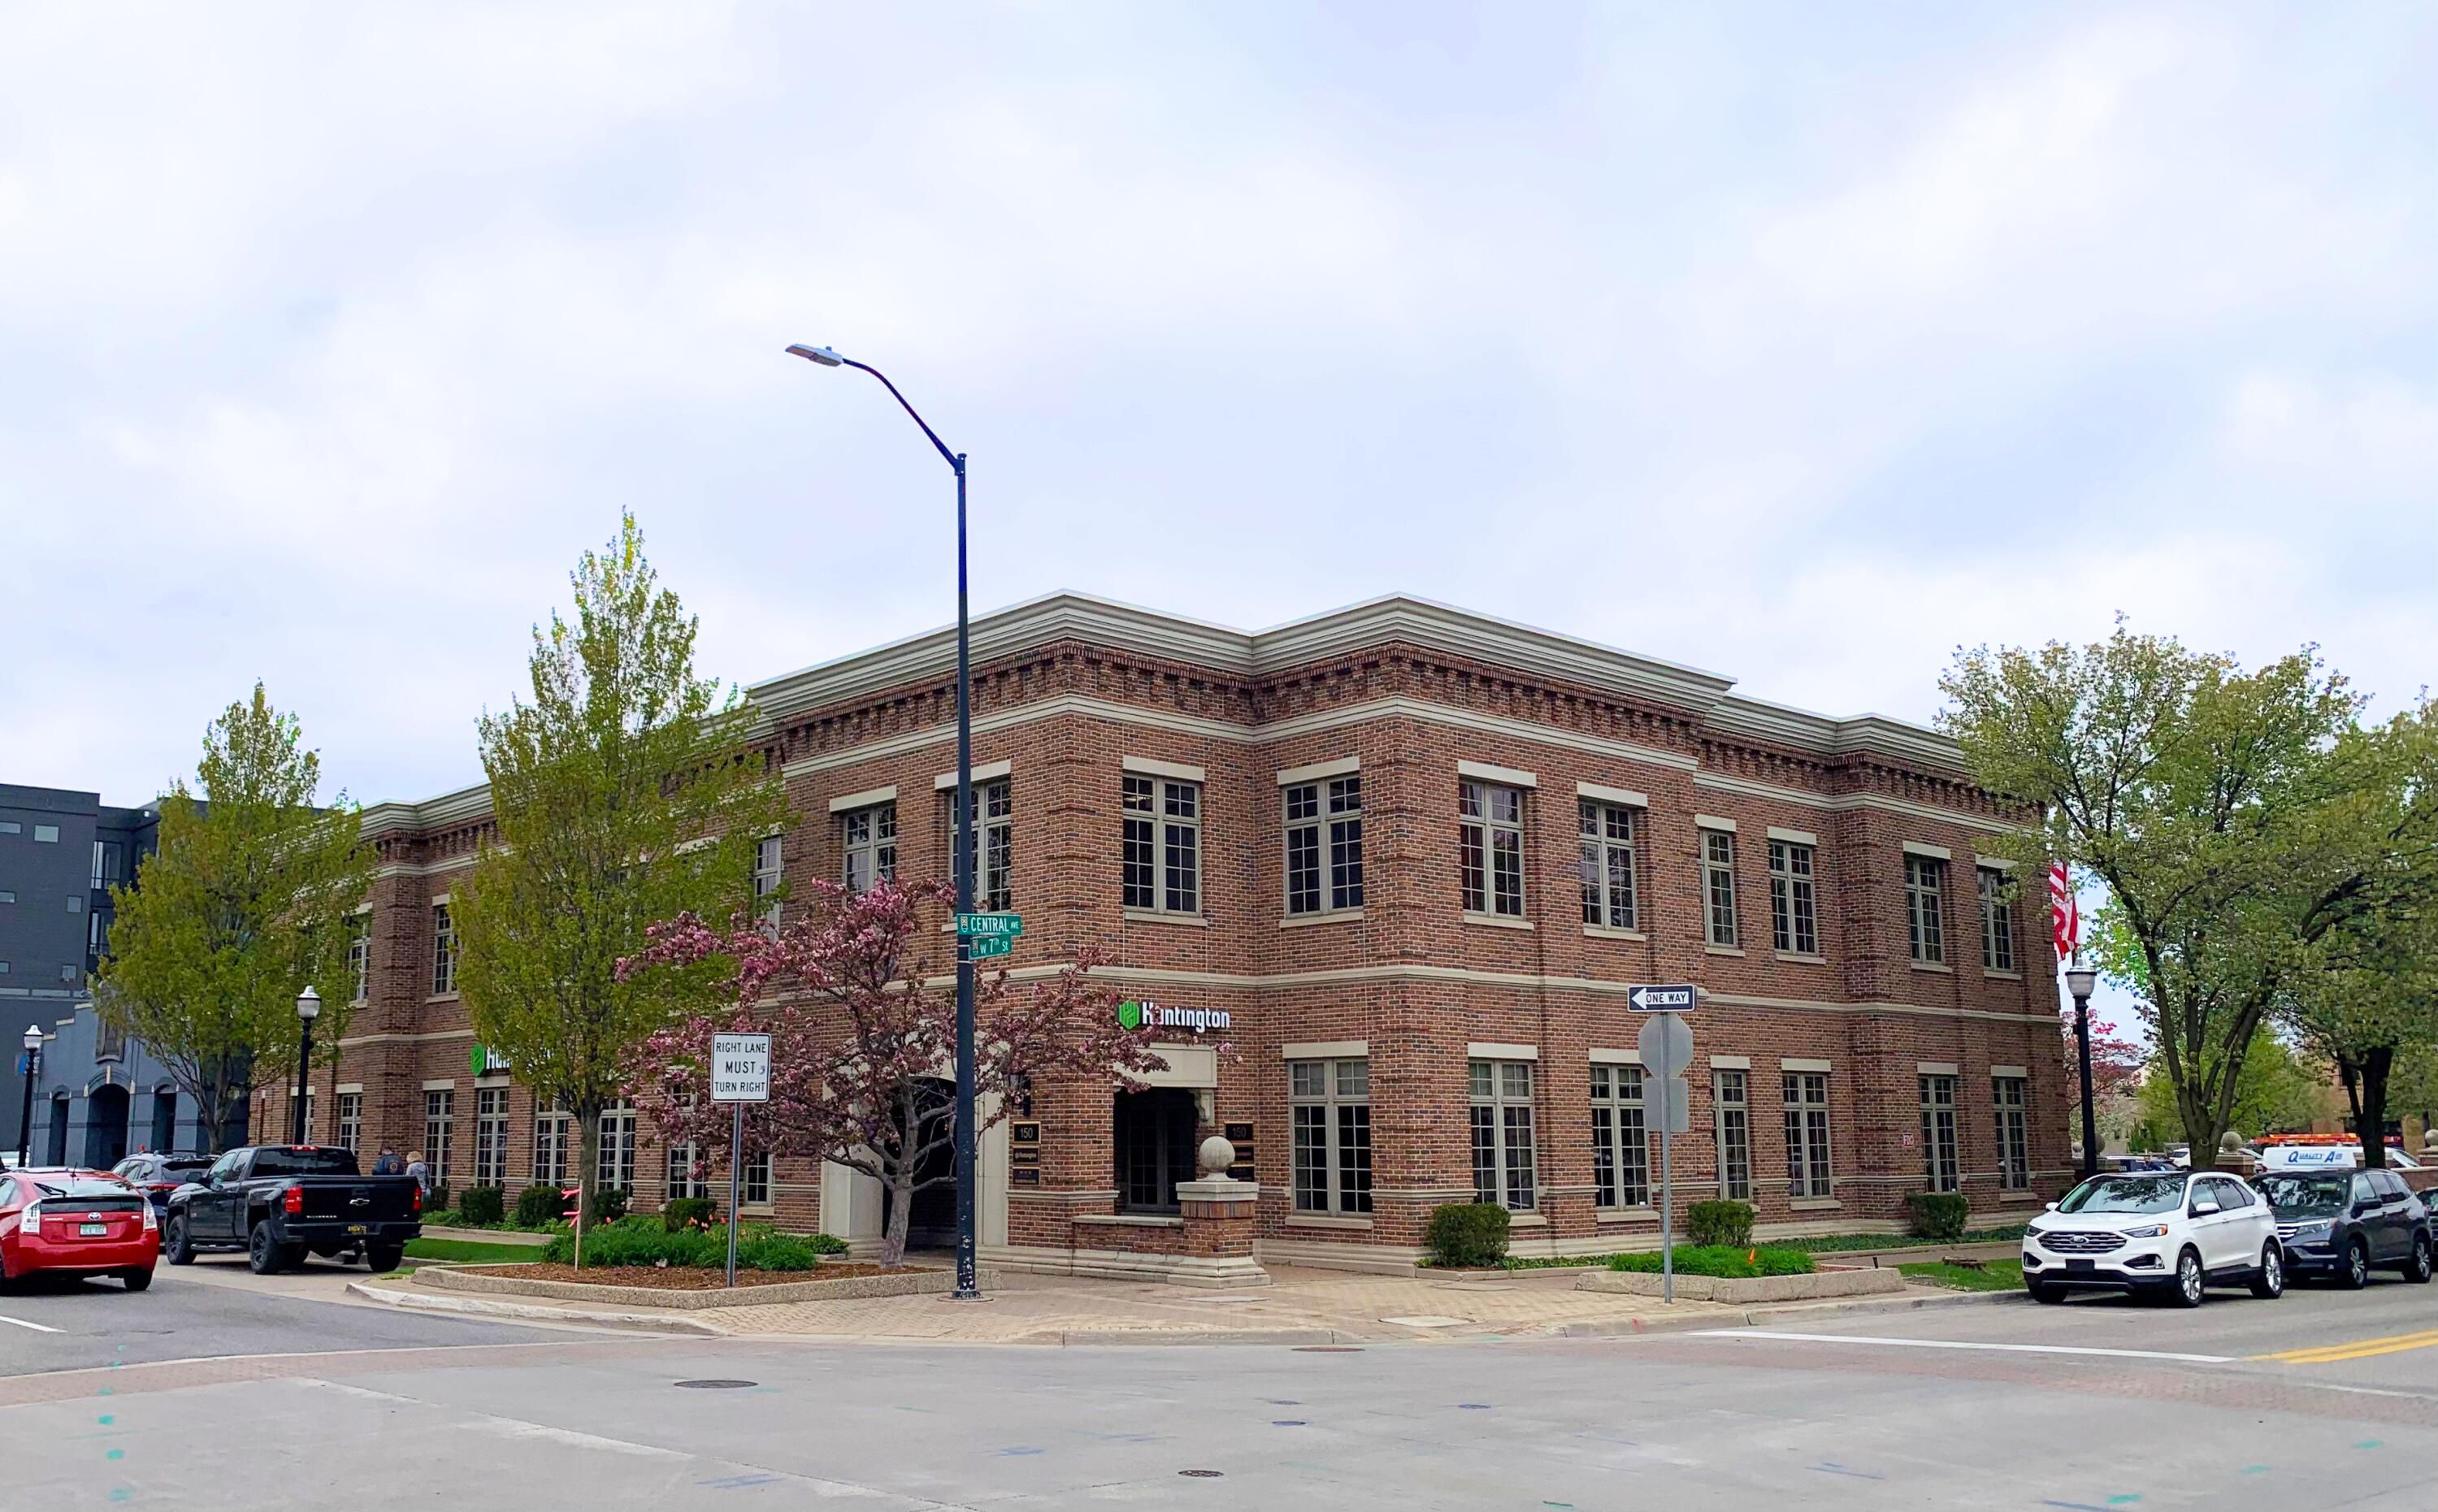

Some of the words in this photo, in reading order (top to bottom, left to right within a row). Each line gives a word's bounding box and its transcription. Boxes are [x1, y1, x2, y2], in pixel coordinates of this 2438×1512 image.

[970, 916, 1009, 933] CENTRAL
[1010, 921, 1019, 929] AVE
[979, 943, 987, 954] W
[1646, 994, 1664, 1003] ONE
[1668, 993, 1687, 1003] WAY
[716, 1042, 741, 1053] RIGHT
[744, 1042, 766, 1053] LANE
[725, 1060, 756, 1074] MUST
[715, 1081, 737, 1092] TURN
[740, 1081, 766, 1092] RIGHT
[1020, 1127, 1033, 1139] 150
[1232, 1126, 1247, 1138] 150
